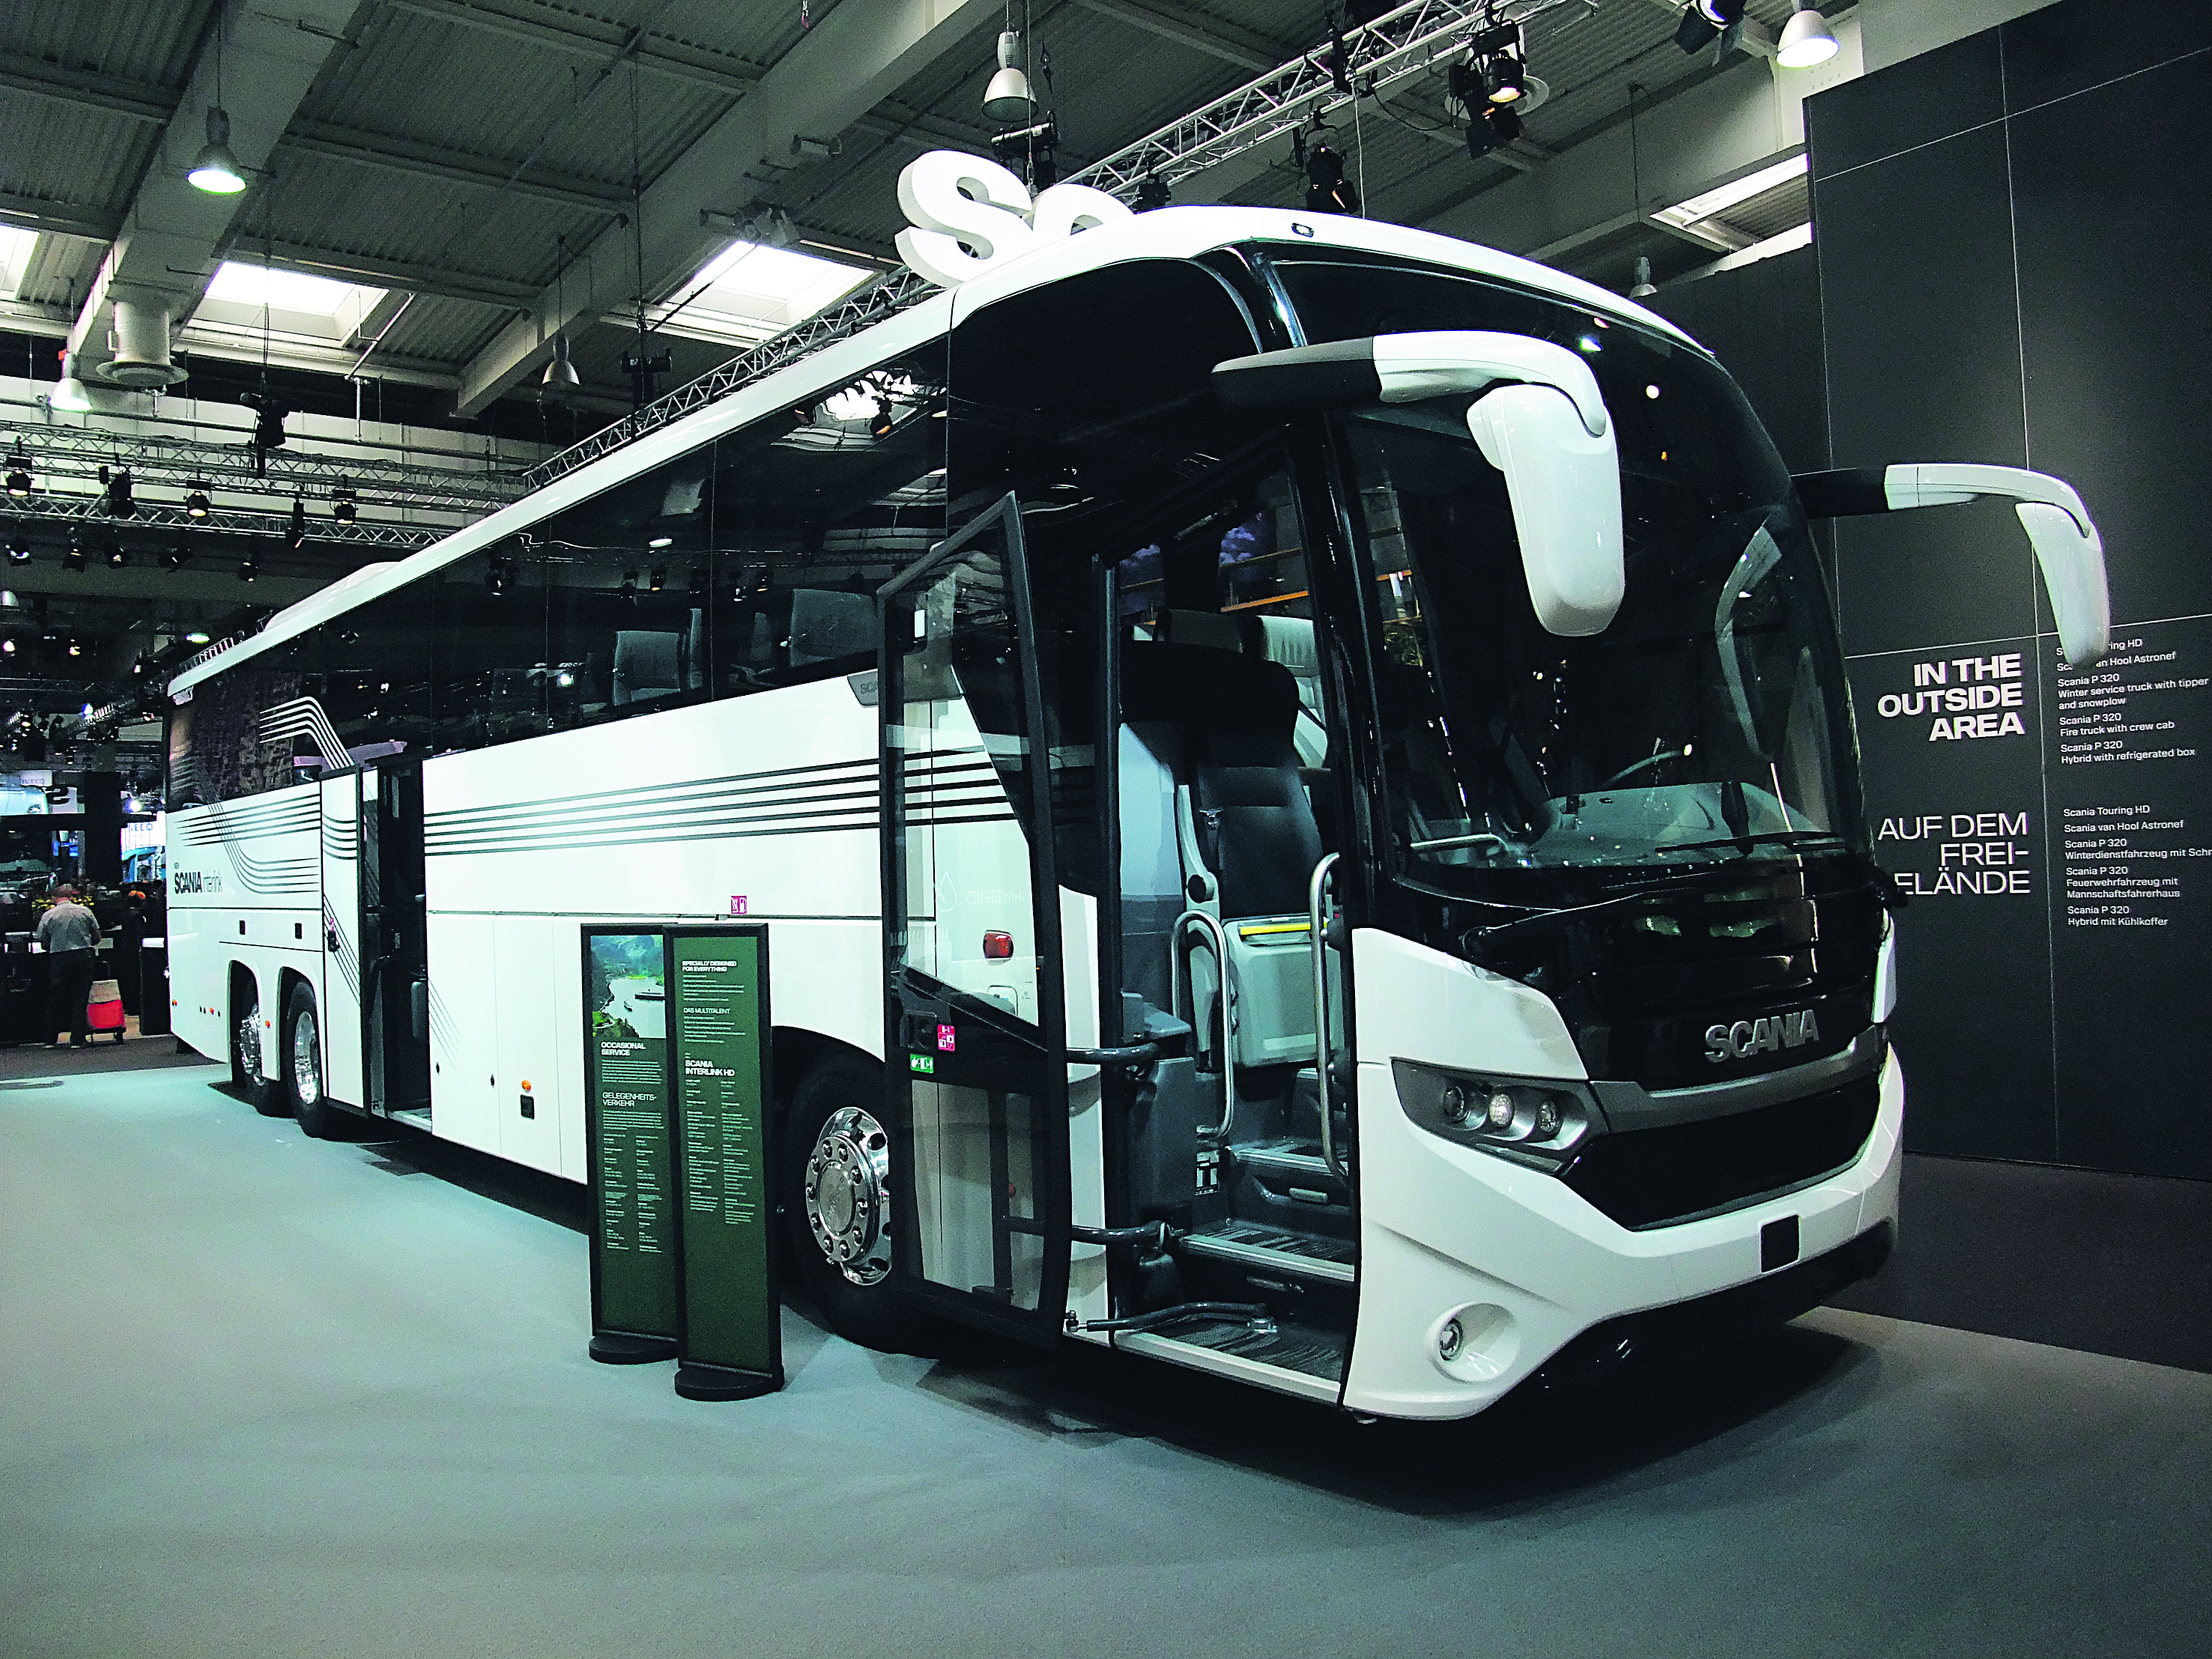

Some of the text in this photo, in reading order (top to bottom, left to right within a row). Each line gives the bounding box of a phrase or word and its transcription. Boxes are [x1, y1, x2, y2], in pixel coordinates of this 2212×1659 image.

[2127, 638, 2143, 648] HD
[2109, 655, 2132, 666] Hool
[2133, 651, 2178, 664] Astronef
[1914, 653, 2022, 686] IN THE
[2057, 673, 2120, 688] Scania P 320
[2058, 678, 2210, 700] Winter service truck with tipper
[1877, 682, 2022, 718] OUTSIDE
[2058, 697, 2127, 711] and snowplow
[1928, 712, 2025, 741] AREA
[2059, 712, 2122, 727] Scania P 320
[2059, 720, 2175, 738] Fire truck with crew cab
[2060, 740, 2123, 753] Scania P 320
[2061, 747, 2196, 765] Hybrid with refrigerated box
[2063, 804, 2151, 818] Scania Touring HD
[1877, 812, 2027, 840] AUF DEM
[2064, 819, 2185, 834] Scania van Hool Astronef
[2064, 838, 2127, 849] Scania P 320
[1940, 842, 2028, 866] FREI-
[2064, 849, 2169, 861] Winterdienstfahrzeug
[2169, 848, 2187, 858] mit
[2065, 866, 2129, 876] Scania P 320
[175, 872, 202, 894] SCANIA
[1894, 866, 2031, 895] ELÄNDE
[2066, 876, 2179, 888] Feuerwehrfahrzeug mit
[2067, 888, 2181, 899] Mannschaftsfahrerhaus
[2067, 906, 2130, 915] Scania P 320
[2067, 916, 2169, 928] Hybrid mit Kühlkoffer
[1704, 1008, 1820, 1063] SCANIA
[601, 1041, 646, 1049] OCCASIONAL
[601, 1048, 631, 1056] SERVICE
[685, 1059, 714, 1068] SCANIA
[685, 1067, 724, 1076] INTERLINK
[602, 1099, 635, 1107] VERKEHR
